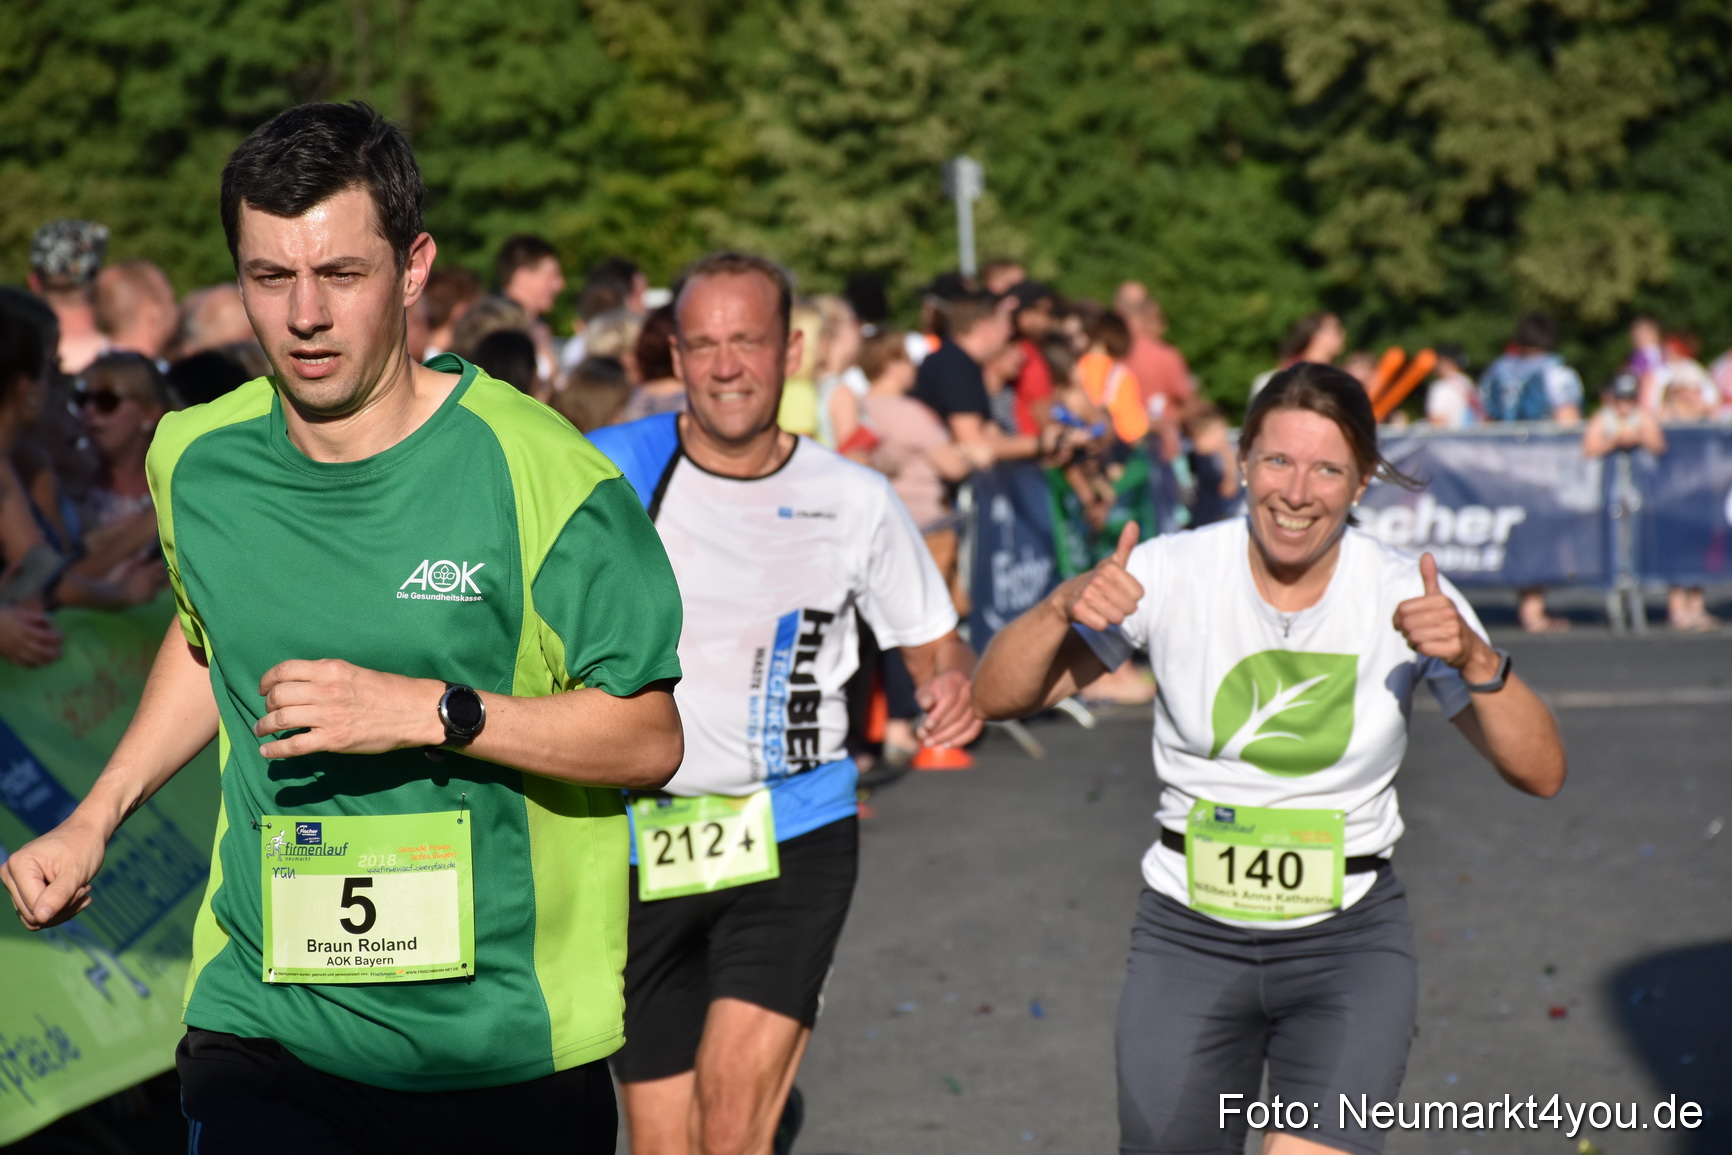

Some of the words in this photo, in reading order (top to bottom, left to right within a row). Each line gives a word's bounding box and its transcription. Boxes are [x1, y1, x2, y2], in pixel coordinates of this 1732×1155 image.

[399, 559, 485, 594] AOK
[285, 842, 349, 856] firmenlauf
[357, 854, 397, 867] 2018
[1218, 846, 1304, 890] 140
[1242, 890, 1273, 901] Anna
[339, 877, 377, 935] 5
[307, 939, 353, 953] Braun
[358, 937, 418, 952] Roland
[327, 957, 351, 966] AOK
[354, 956, 394, 968] Bayern
